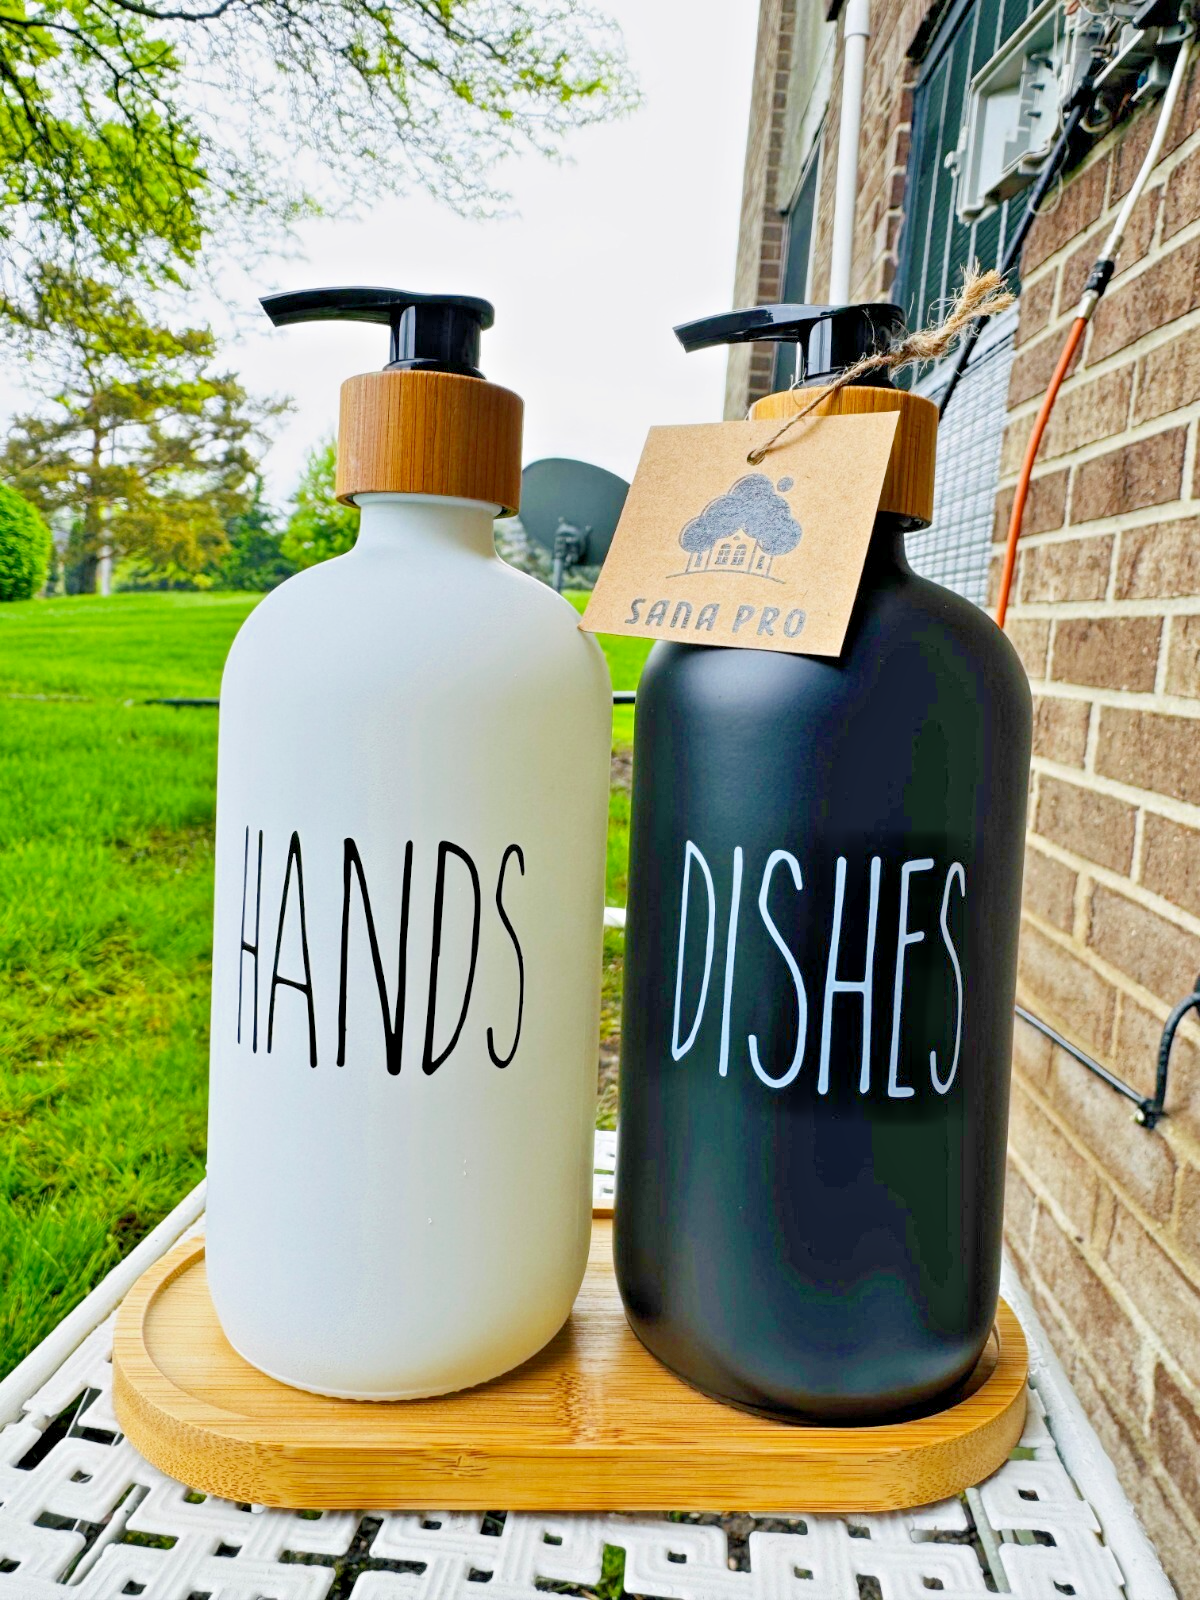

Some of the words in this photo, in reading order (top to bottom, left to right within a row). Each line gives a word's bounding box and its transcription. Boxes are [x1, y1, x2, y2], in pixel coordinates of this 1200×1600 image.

[624, 598, 720, 632] SANA
[731, 604, 807, 638] PRO
[237, 825, 525, 1076] HANDS
[671, 840, 966, 1098] DISHES
